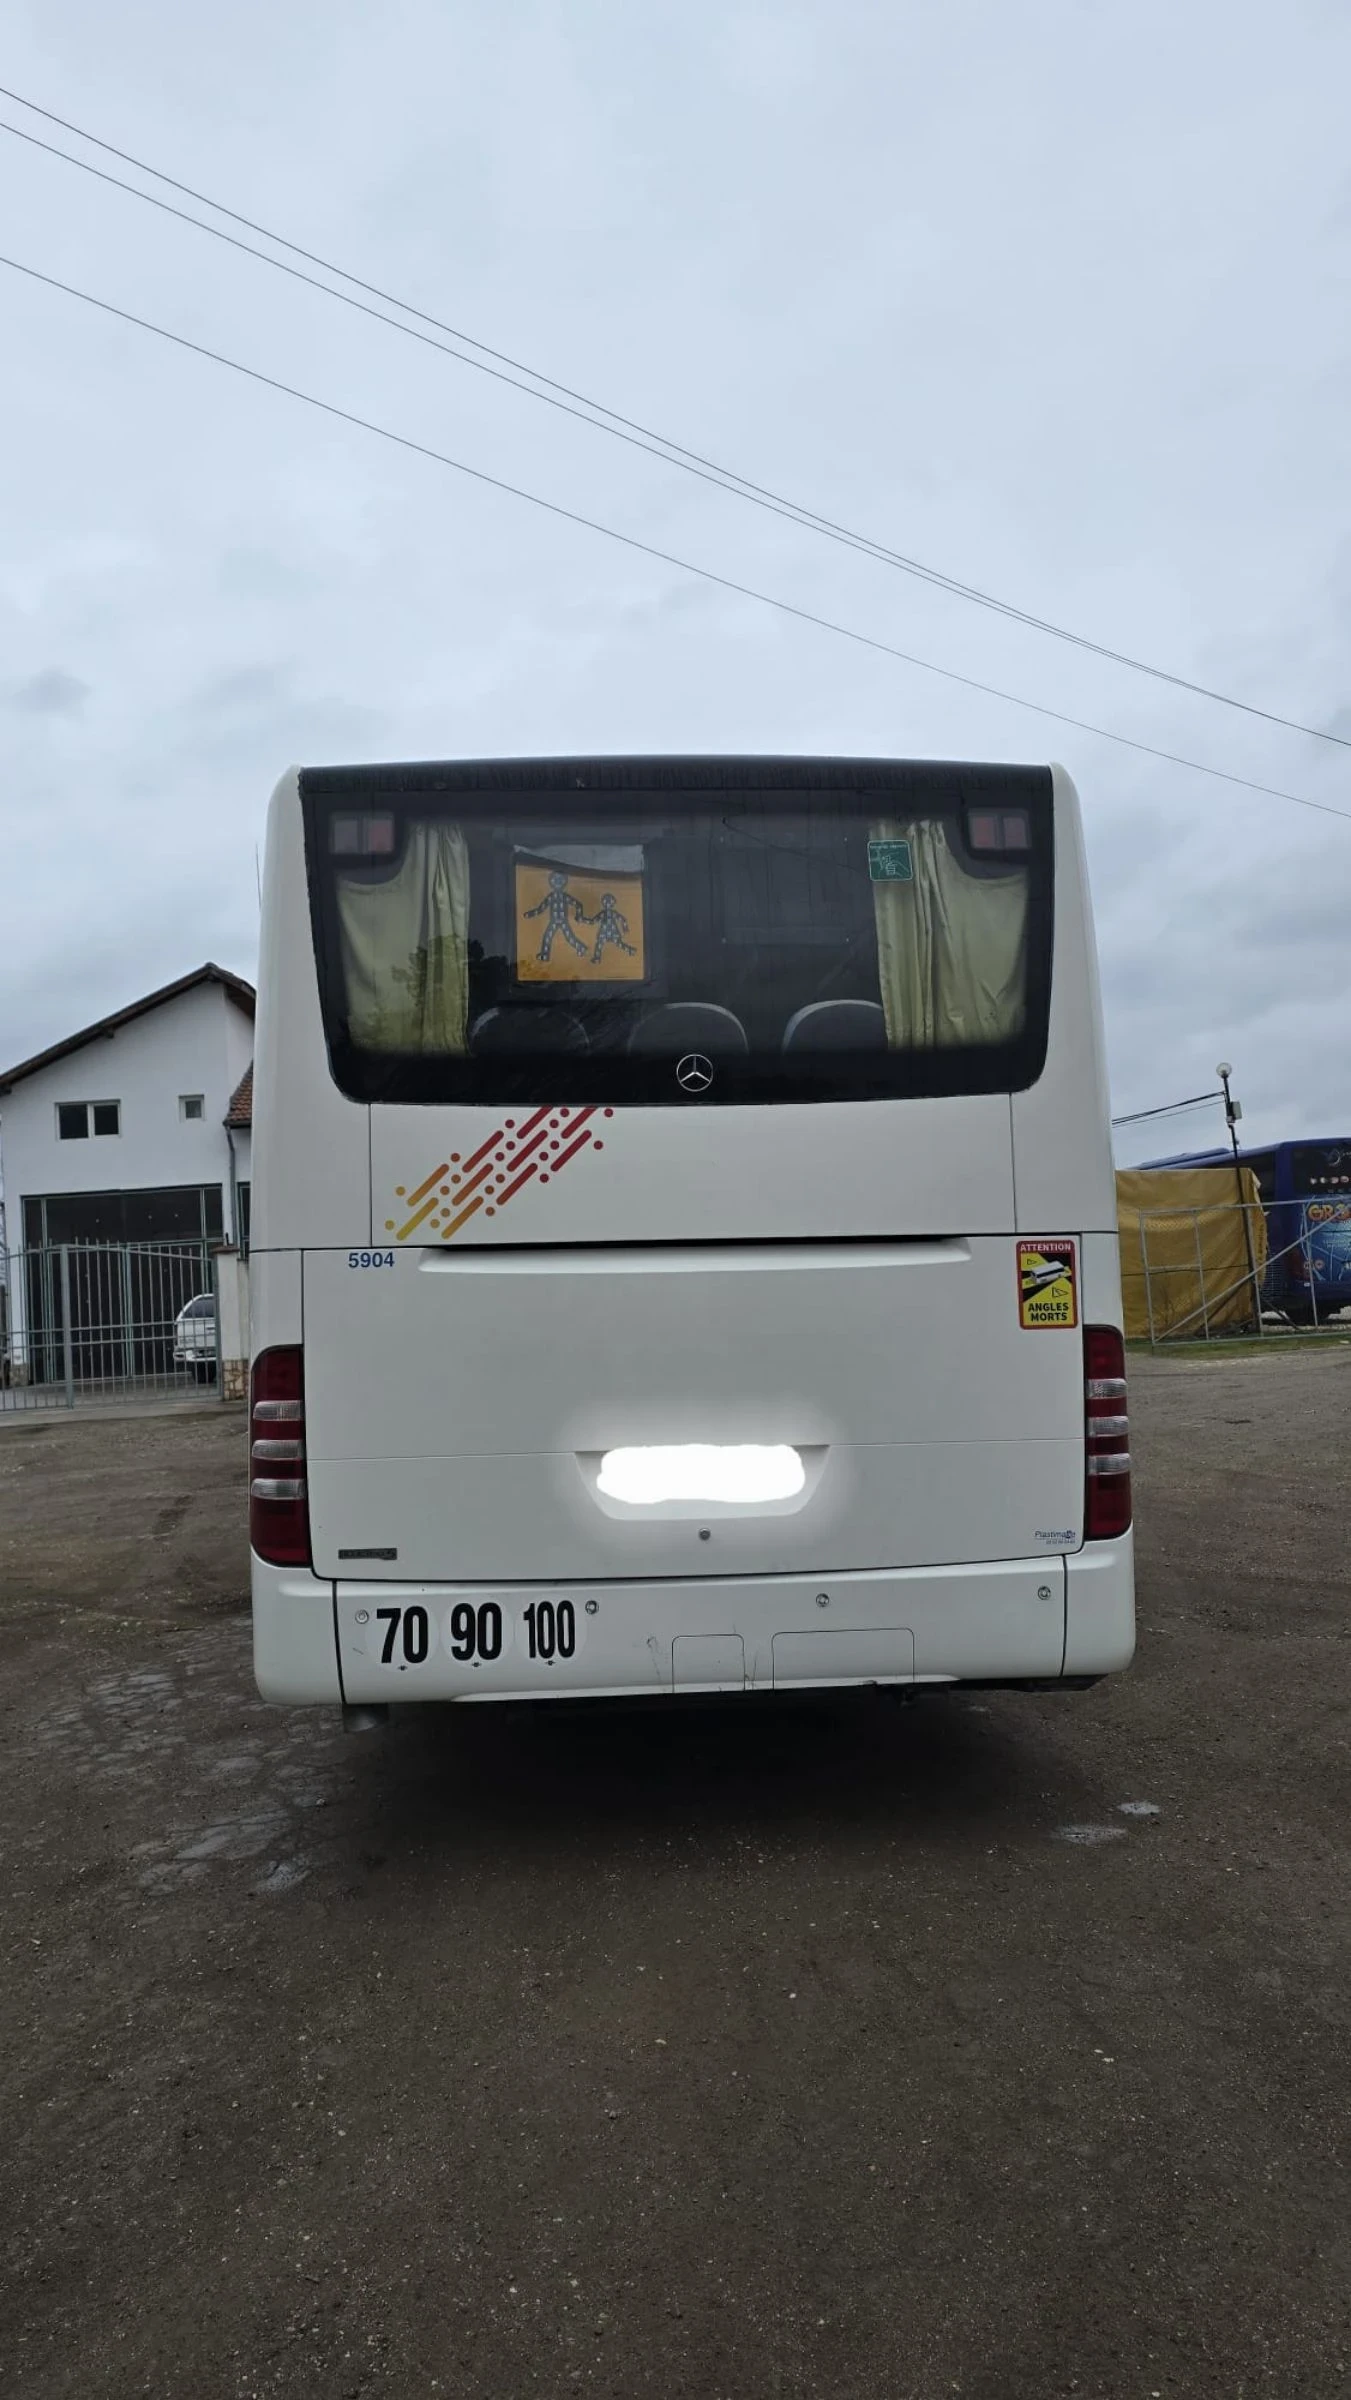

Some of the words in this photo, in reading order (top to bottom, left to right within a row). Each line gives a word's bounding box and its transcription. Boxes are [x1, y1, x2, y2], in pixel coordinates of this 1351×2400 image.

[1020, 1243, 1071, 1251] ATTENTION
[348, 1252, 395, 1268] 5904
[1028, 1303, 1069, 1312] ANGLES
[1030, 1313, 1068, 1322] MORTS
[376, 1606, 428, 1664] 70
[451, 1602, 502, 1661] 90
[523, 1600, 575, 1659] 100
